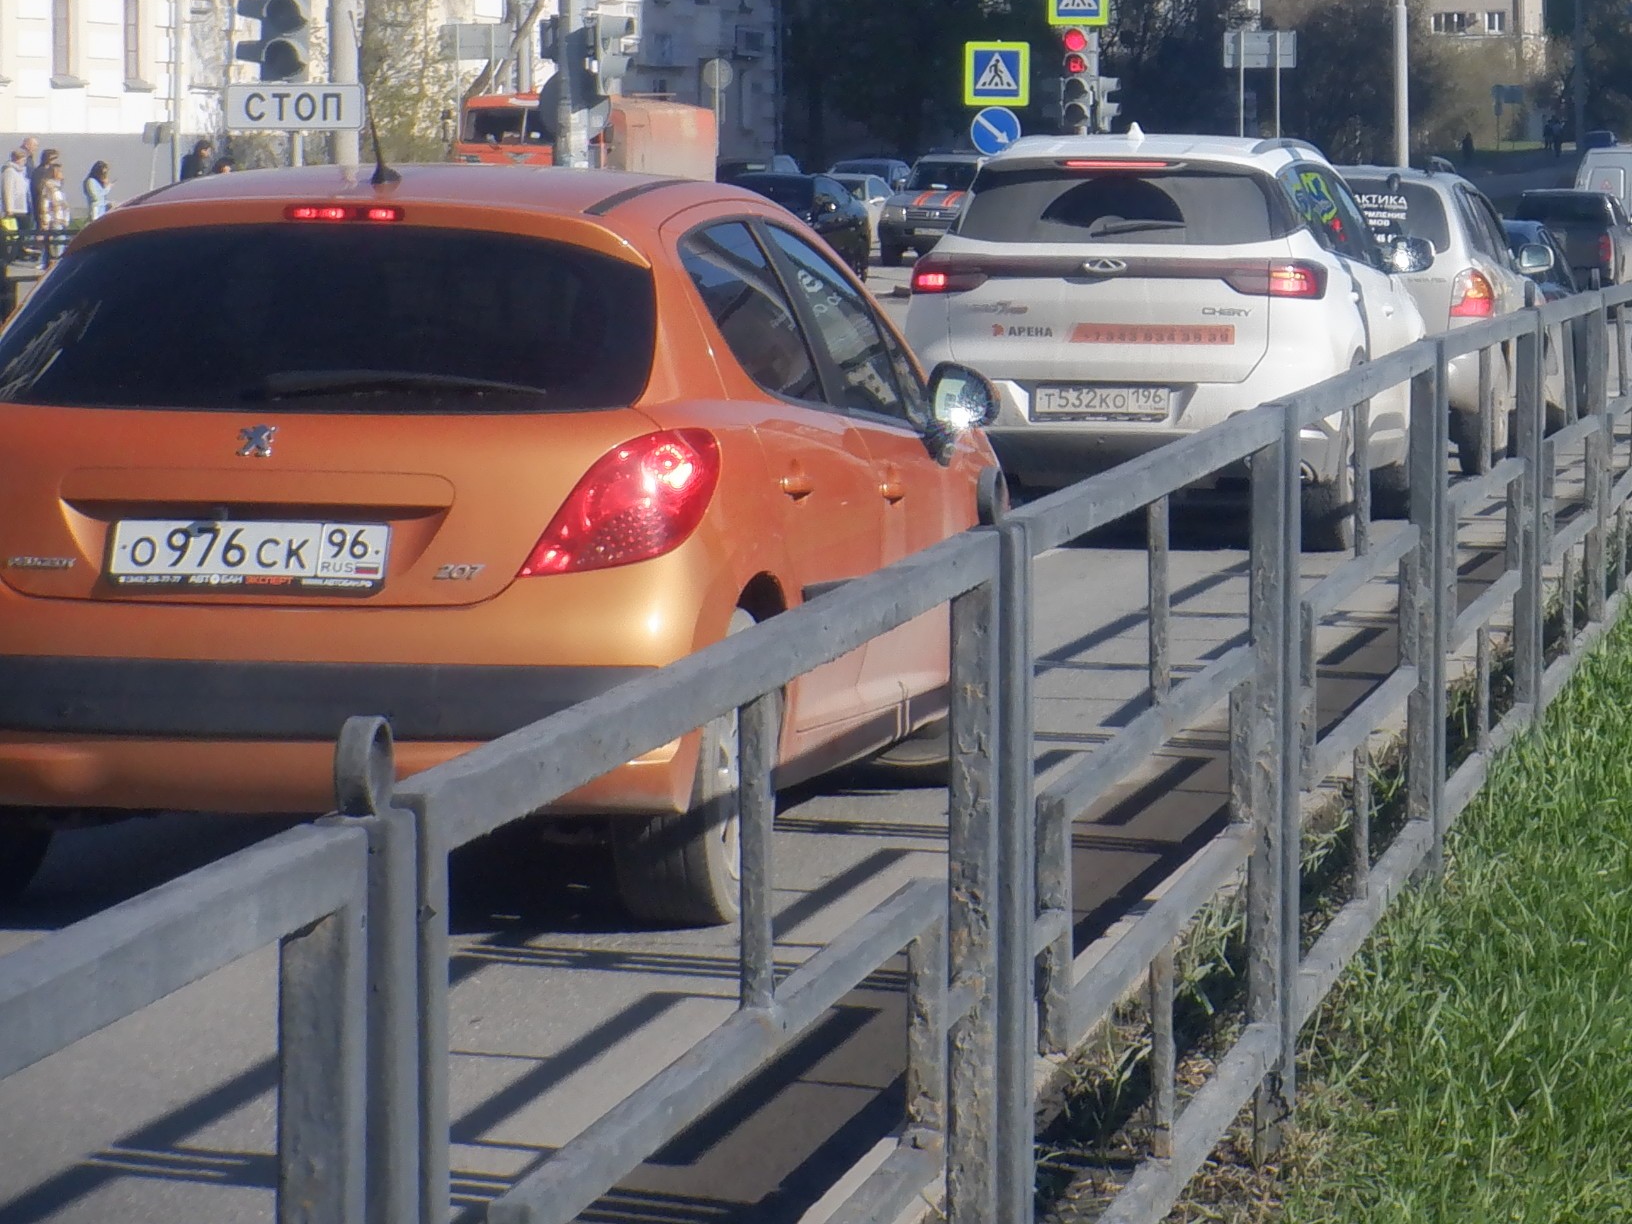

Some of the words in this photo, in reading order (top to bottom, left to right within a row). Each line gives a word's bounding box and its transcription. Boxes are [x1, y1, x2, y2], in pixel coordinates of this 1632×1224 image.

[245, 92, 342, 122] СТОП
[1354, 194, 1408, 205] АКТИКА
[1201, 306, 1252, 318] CHERY
[1007, 324, 1053, 338] АРЕНА
[1044, 388, 1126, 410] Т532КО
[1131, 388, 1164, 404] 196
[130, 528, 310, 569] О976СК
[327, 529, 369, 560] 96
[320, 561, 354, 574] RUS
[433, 563, 486, 580] 207
